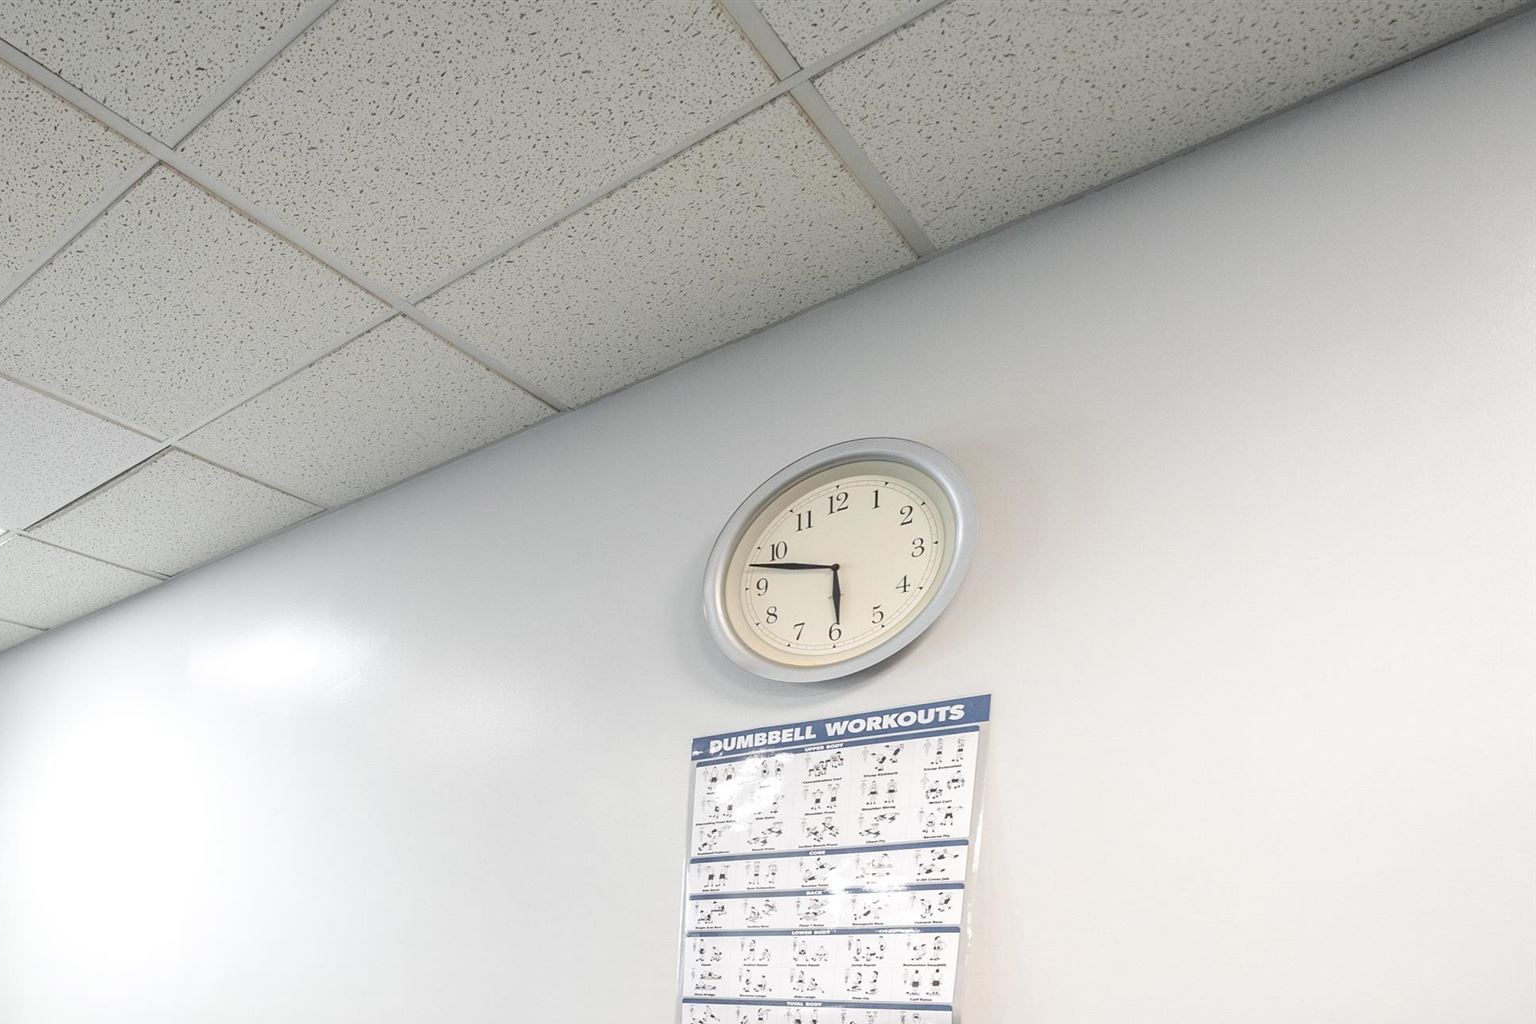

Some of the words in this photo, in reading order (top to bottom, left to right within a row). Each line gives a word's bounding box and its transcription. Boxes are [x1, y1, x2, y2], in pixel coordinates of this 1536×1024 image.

[827, 491, 849, 515] 12
[871, 490, 881, 509] 1
[795, 510, 813, 532] 11
[899, 505, 915, 527] 2
[769, 541, 788, 562] 10
[910, 537, 925, 558] 3
[756, 577, 768, 597] 9
[895, 574, 911, 594] 4
[765, 606, 778, 624] 8
[871, 605, 884, 625] 5
[793, 622, 805, 641] 7
[828, 622, 842, 641] 6
[709, 725, 816, 754] DUMBBELL
[825, 704, 965, 737] WORKOUTS
